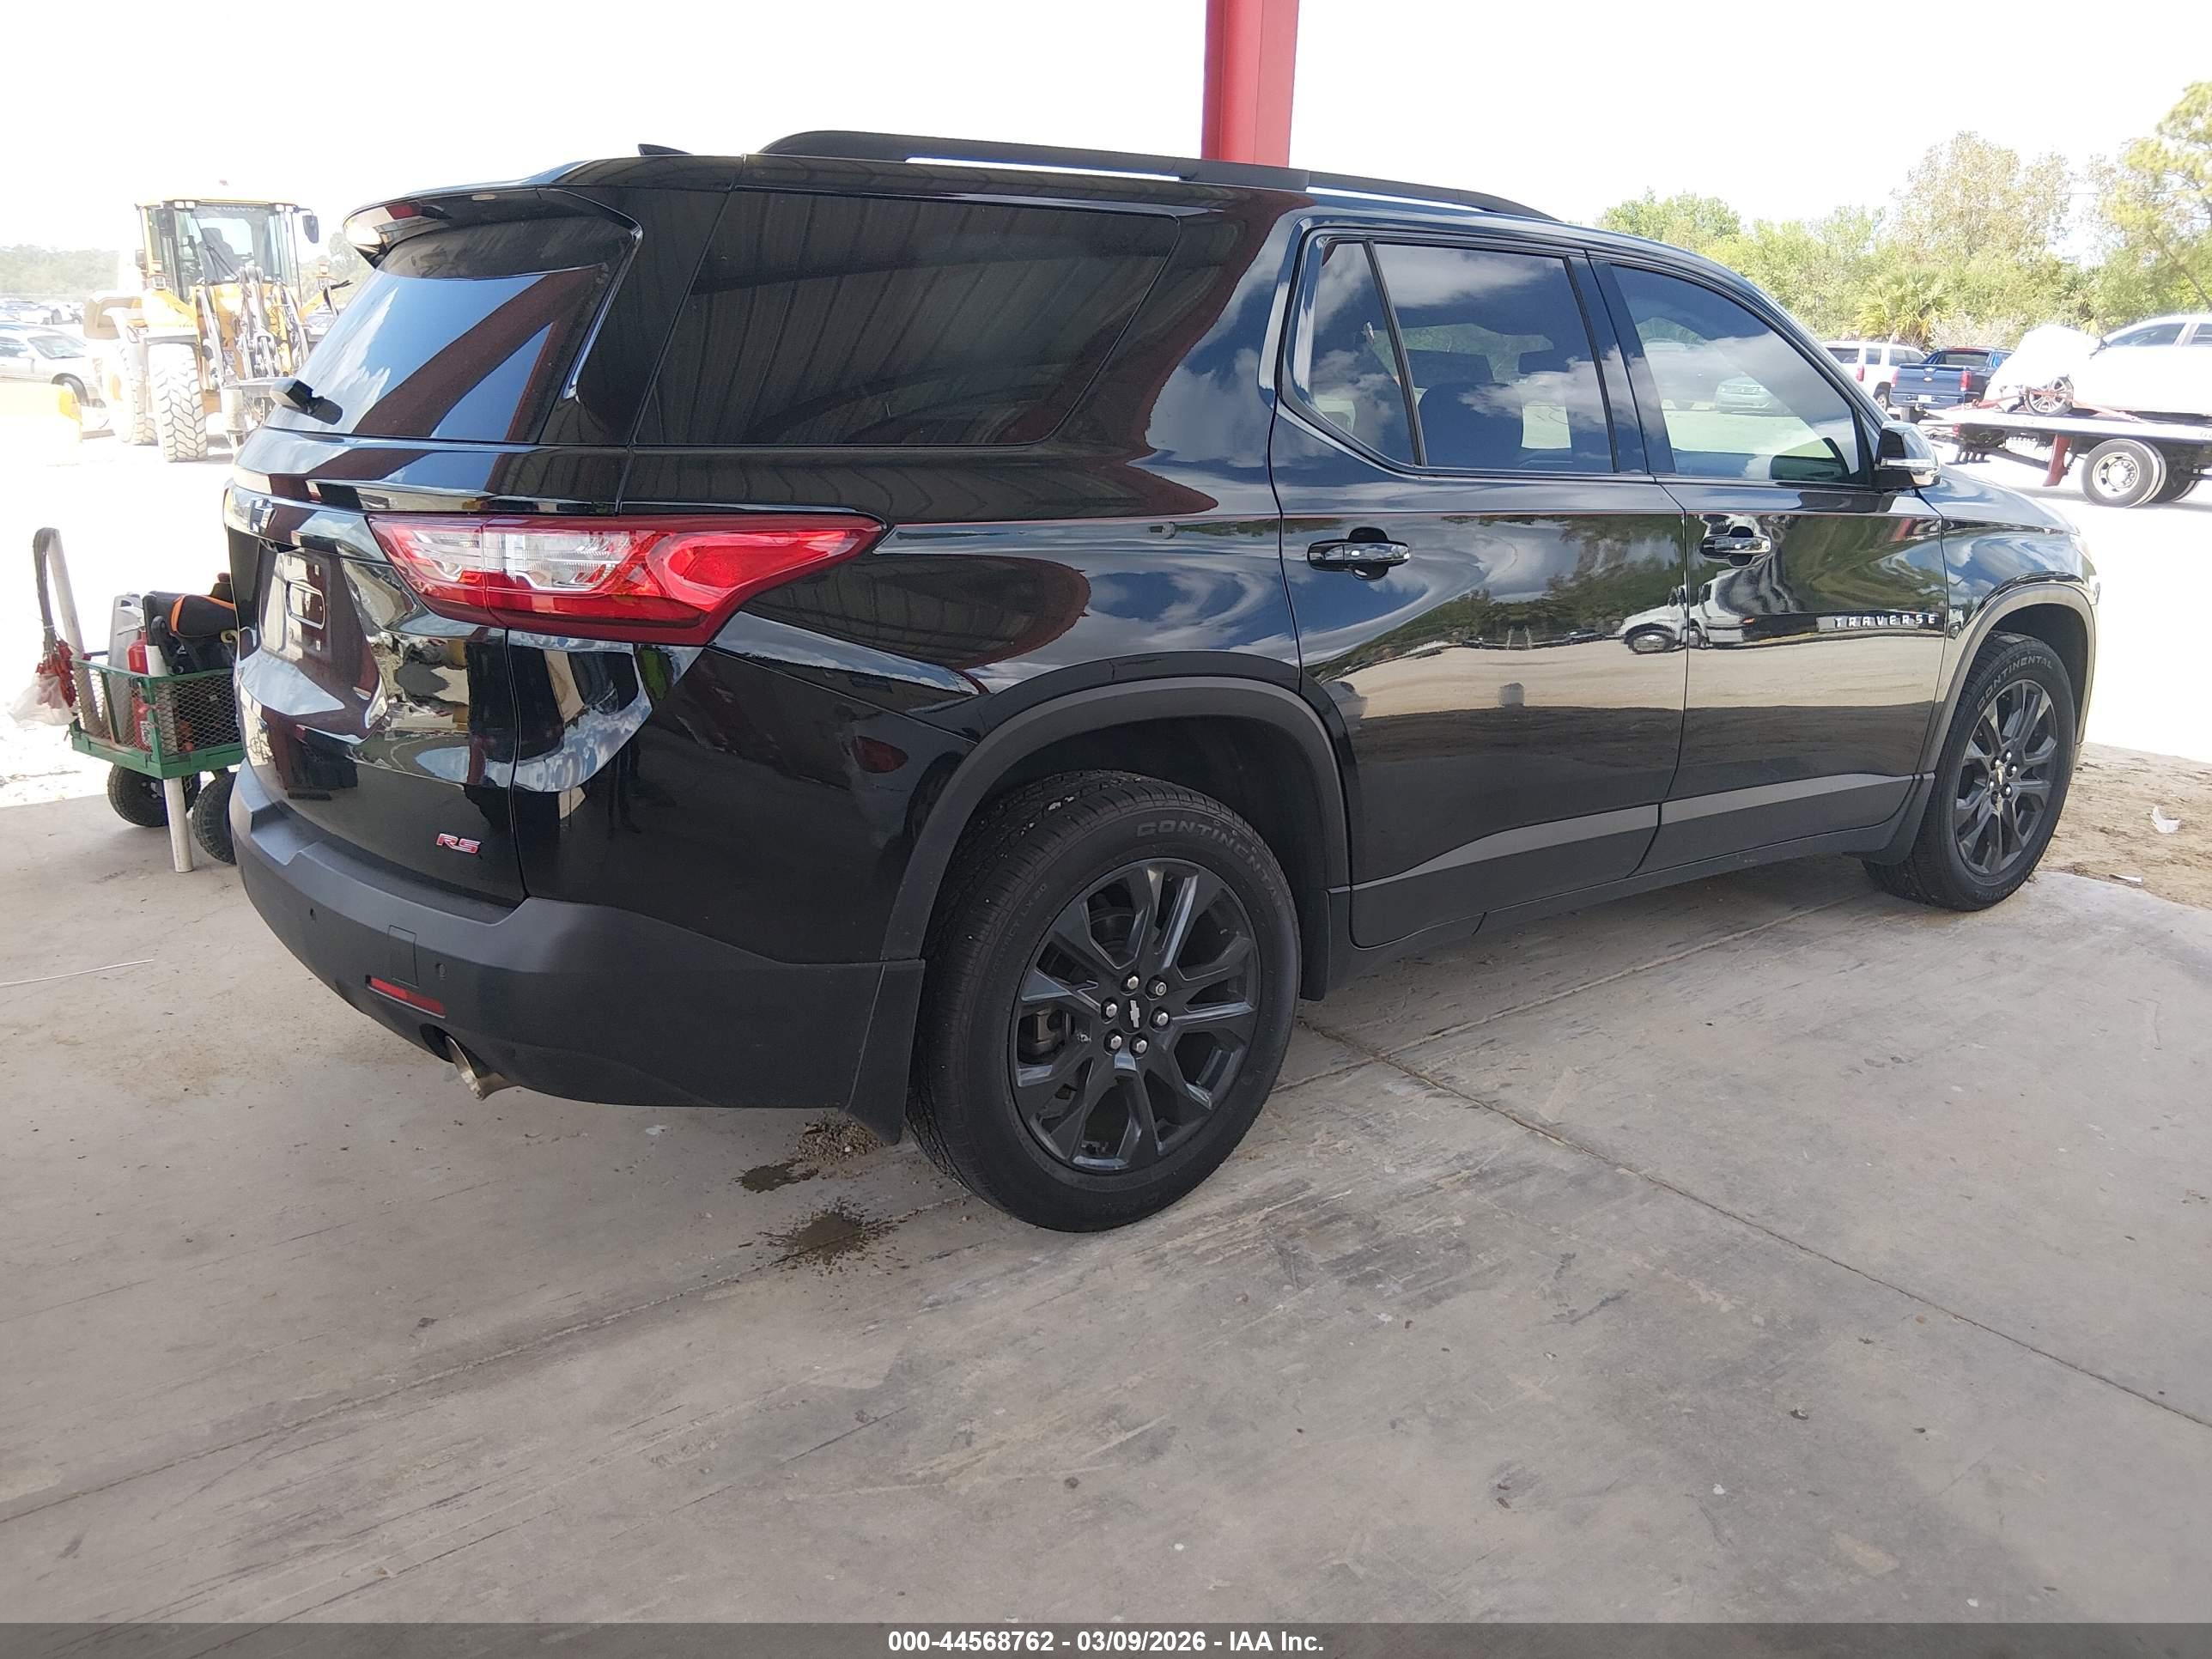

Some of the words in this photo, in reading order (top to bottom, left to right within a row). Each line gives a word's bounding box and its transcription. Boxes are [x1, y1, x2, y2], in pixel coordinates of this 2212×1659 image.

[1834, 614, 1936, 628] TRAVERSE
[1977, 655, 2053, 713] CONTINENTAL
[436, 833, 481, 854] RS
